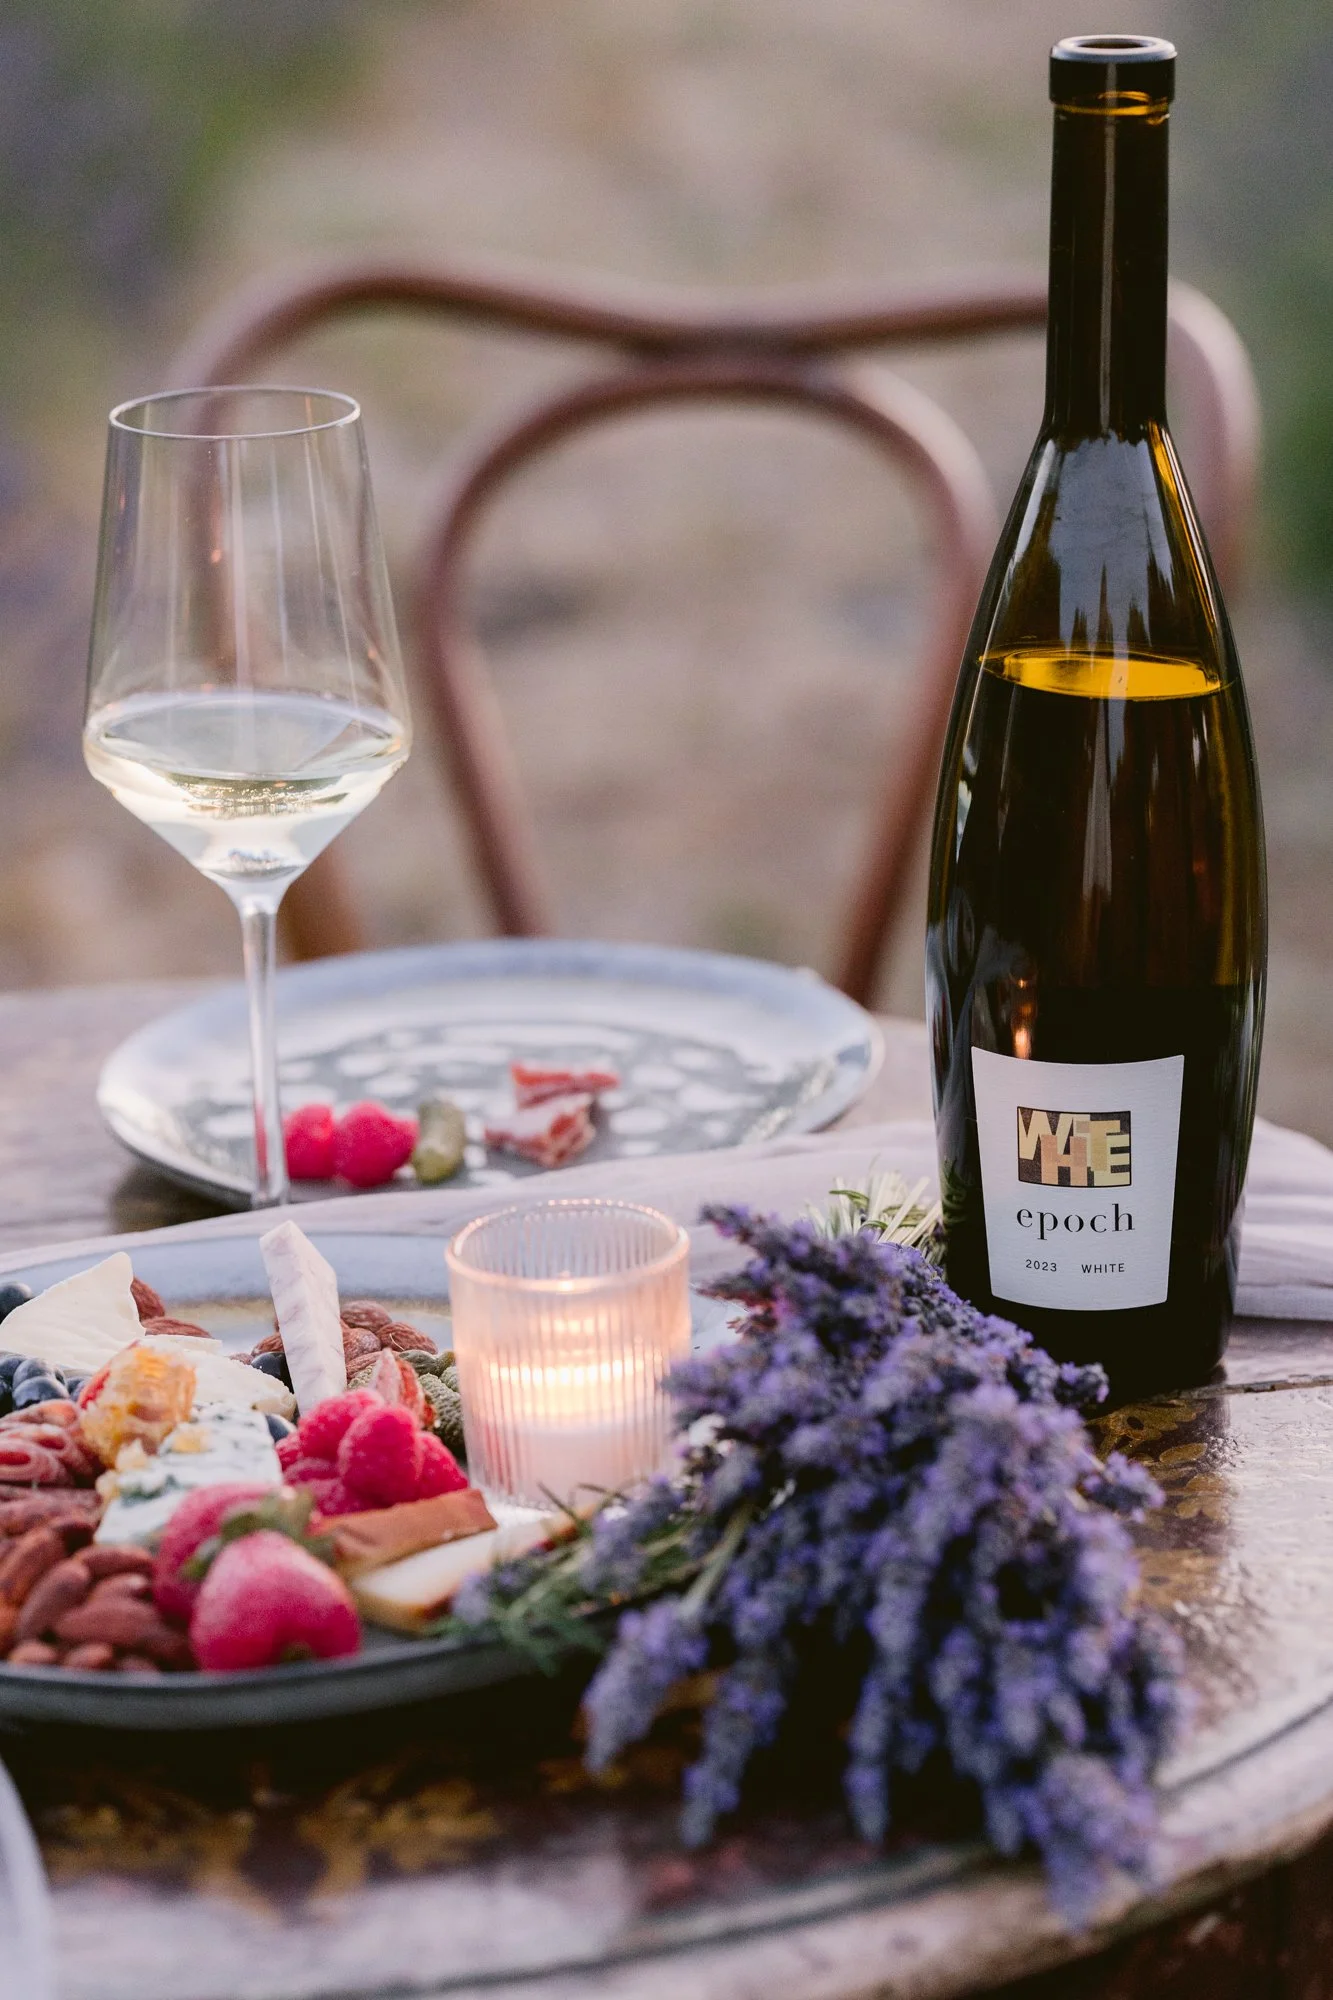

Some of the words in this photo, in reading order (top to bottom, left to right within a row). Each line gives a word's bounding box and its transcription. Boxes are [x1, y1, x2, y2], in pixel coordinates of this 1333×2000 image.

[1016, 1203, 1135, 1240] epoch
[1025, 1259, 1058, 1272] 2023
[1081, 1262, 1125, 1274] WHITE
